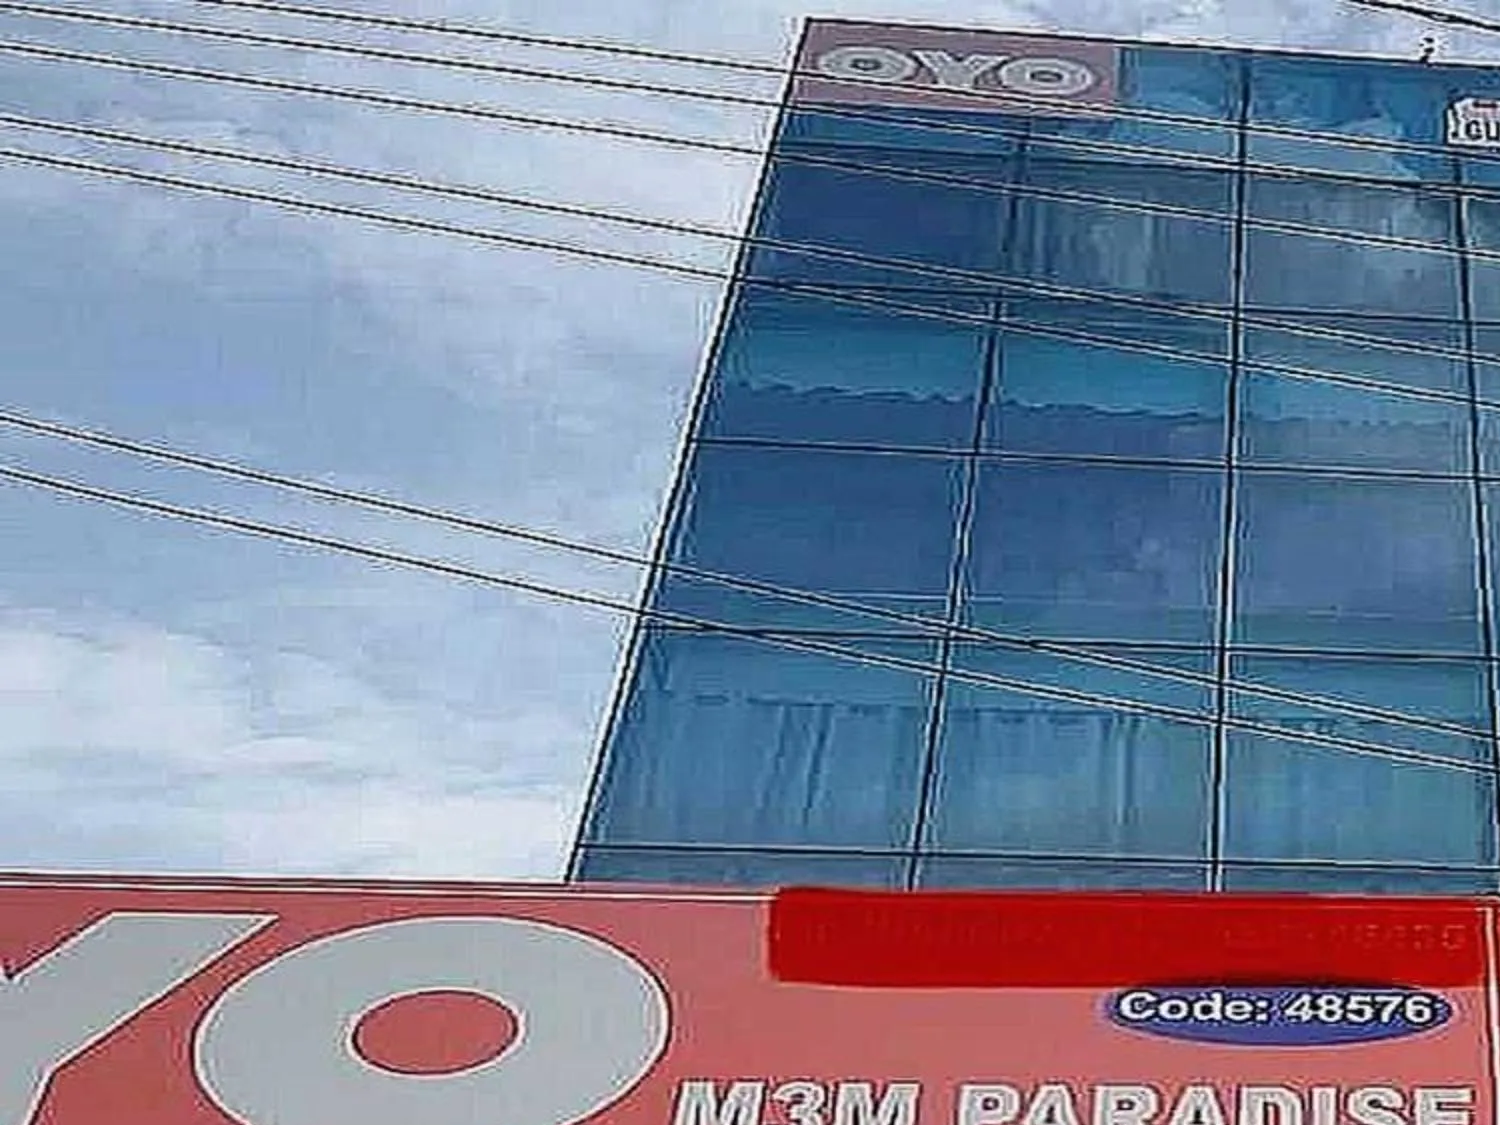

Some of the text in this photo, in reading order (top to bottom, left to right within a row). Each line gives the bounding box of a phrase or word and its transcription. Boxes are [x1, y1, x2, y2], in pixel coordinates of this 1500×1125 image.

[817, 45, 1093, 97] OYO
[1119, 990, 1433, 1024] Code: 48576
